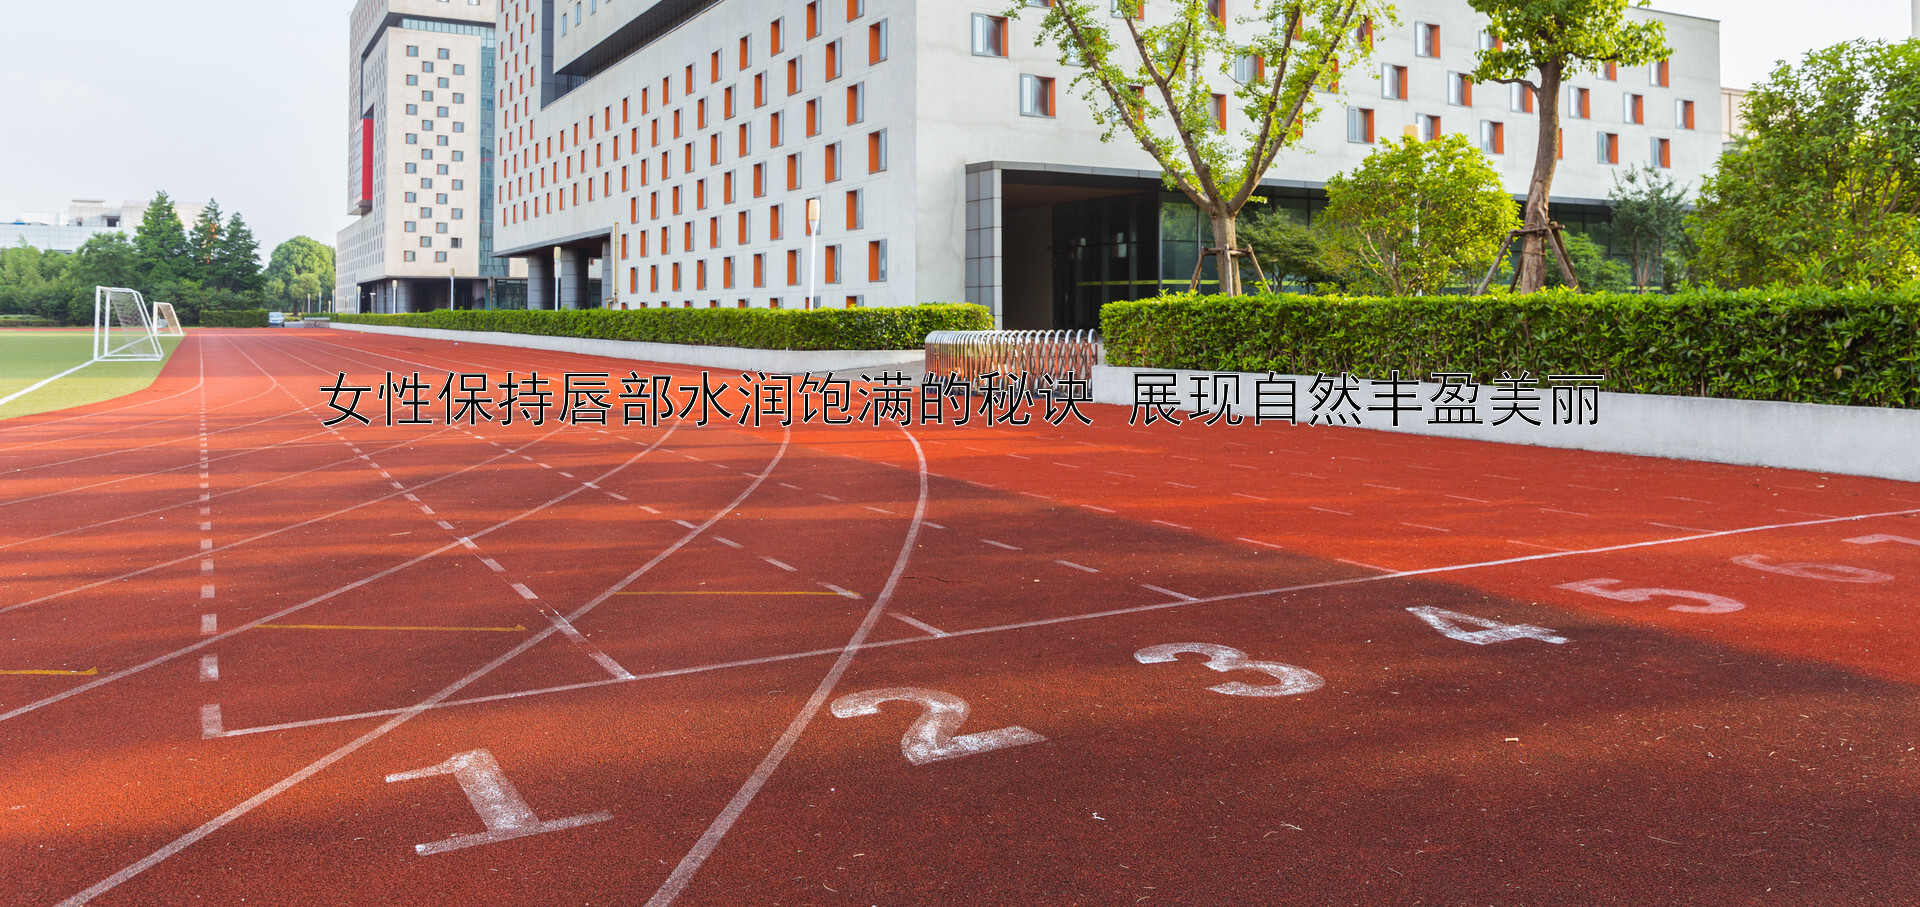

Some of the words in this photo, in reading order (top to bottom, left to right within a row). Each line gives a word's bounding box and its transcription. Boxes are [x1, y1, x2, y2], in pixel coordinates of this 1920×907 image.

[1730, 554, 1895, 583] 6
[1554, 579, 1745, 613] 5
[1405, 605, 1570, 645] 4
[1134, 642, 1326, 697] 3
[830, 686, 1047, 765] 2
[385, 748, 613, 856] 1
